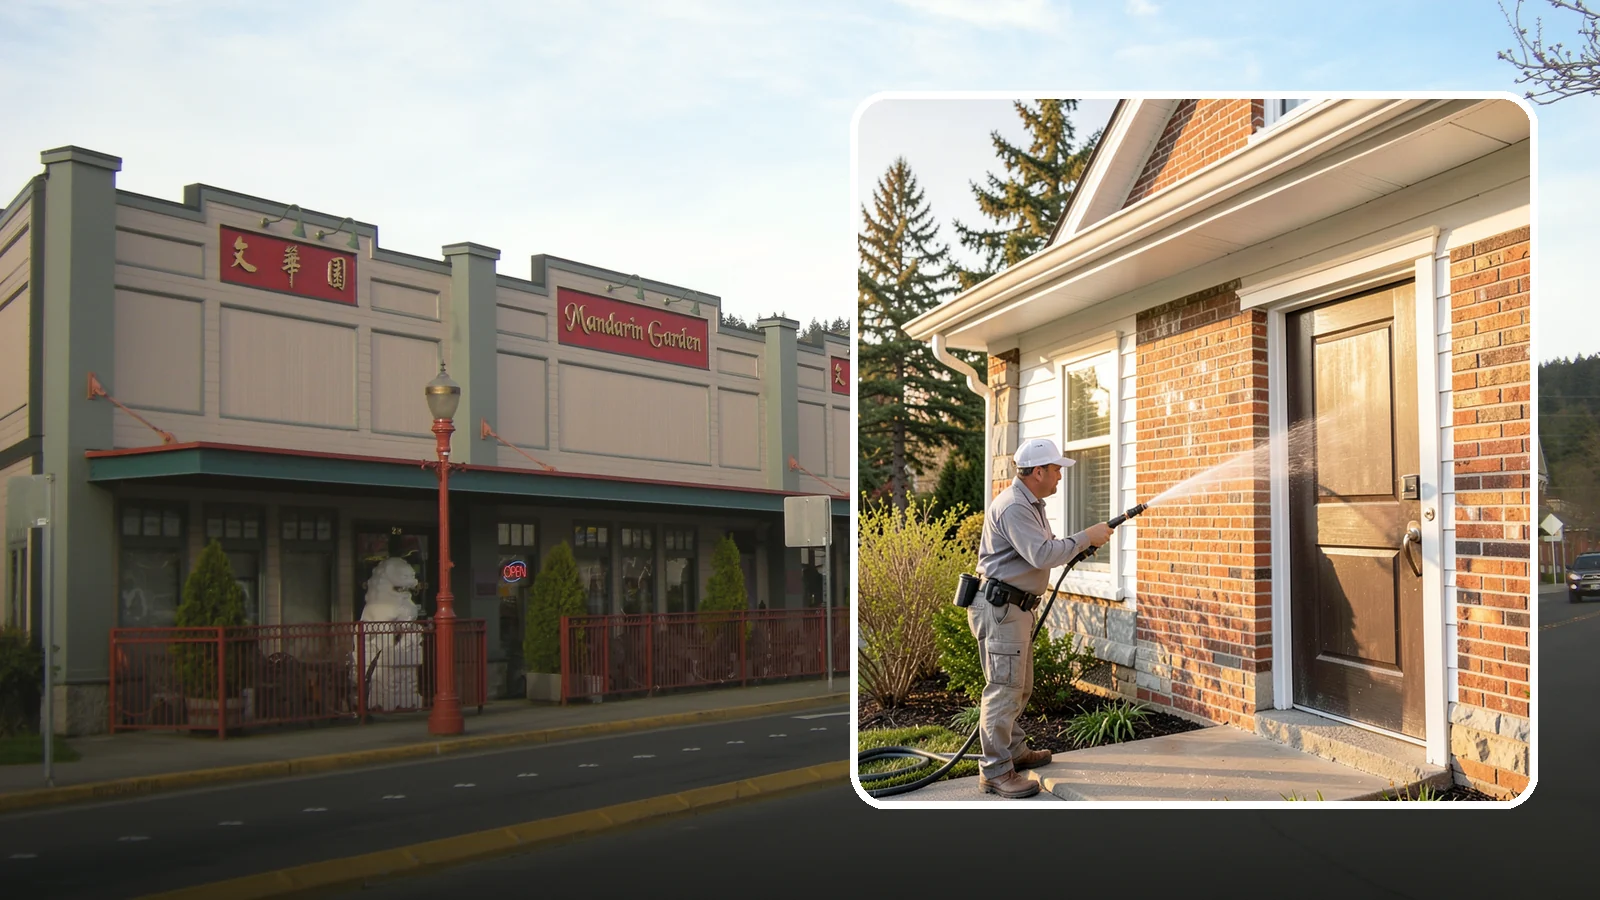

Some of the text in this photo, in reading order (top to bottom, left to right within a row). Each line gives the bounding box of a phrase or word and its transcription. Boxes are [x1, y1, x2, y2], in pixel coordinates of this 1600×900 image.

[564, 302, 701, 352] Mandarin Garden
[503, 565, 527, 578] OPEN
